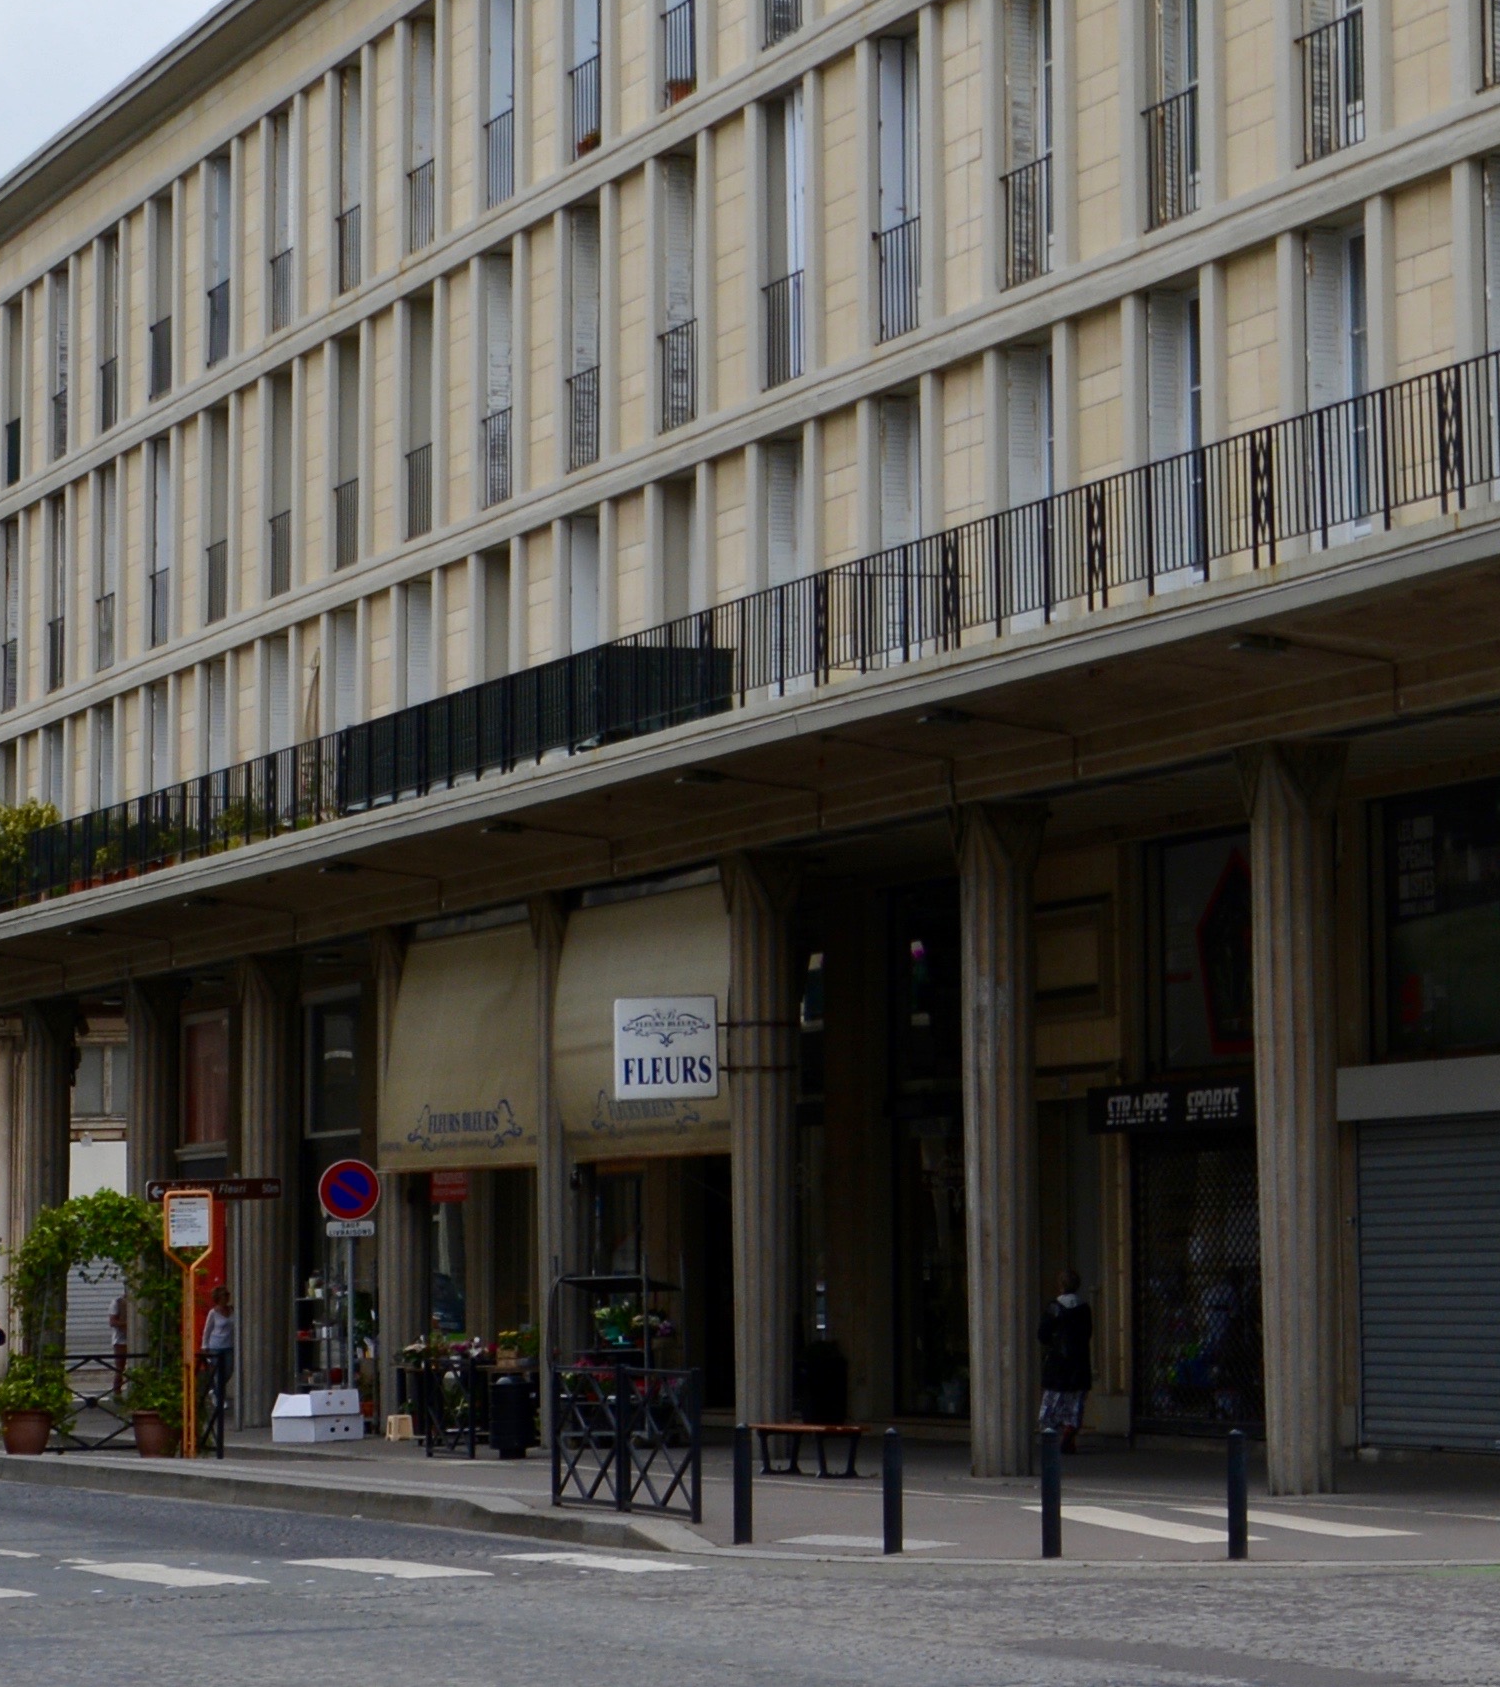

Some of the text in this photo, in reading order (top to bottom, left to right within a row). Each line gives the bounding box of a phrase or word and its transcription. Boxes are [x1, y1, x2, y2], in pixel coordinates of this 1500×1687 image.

[623, 1054, 713, 1086] FLEURS
[1185, 1086, 1240, 1122] SPORTS
[429, 1111, 499, 1134] FLEURS BLEUES
